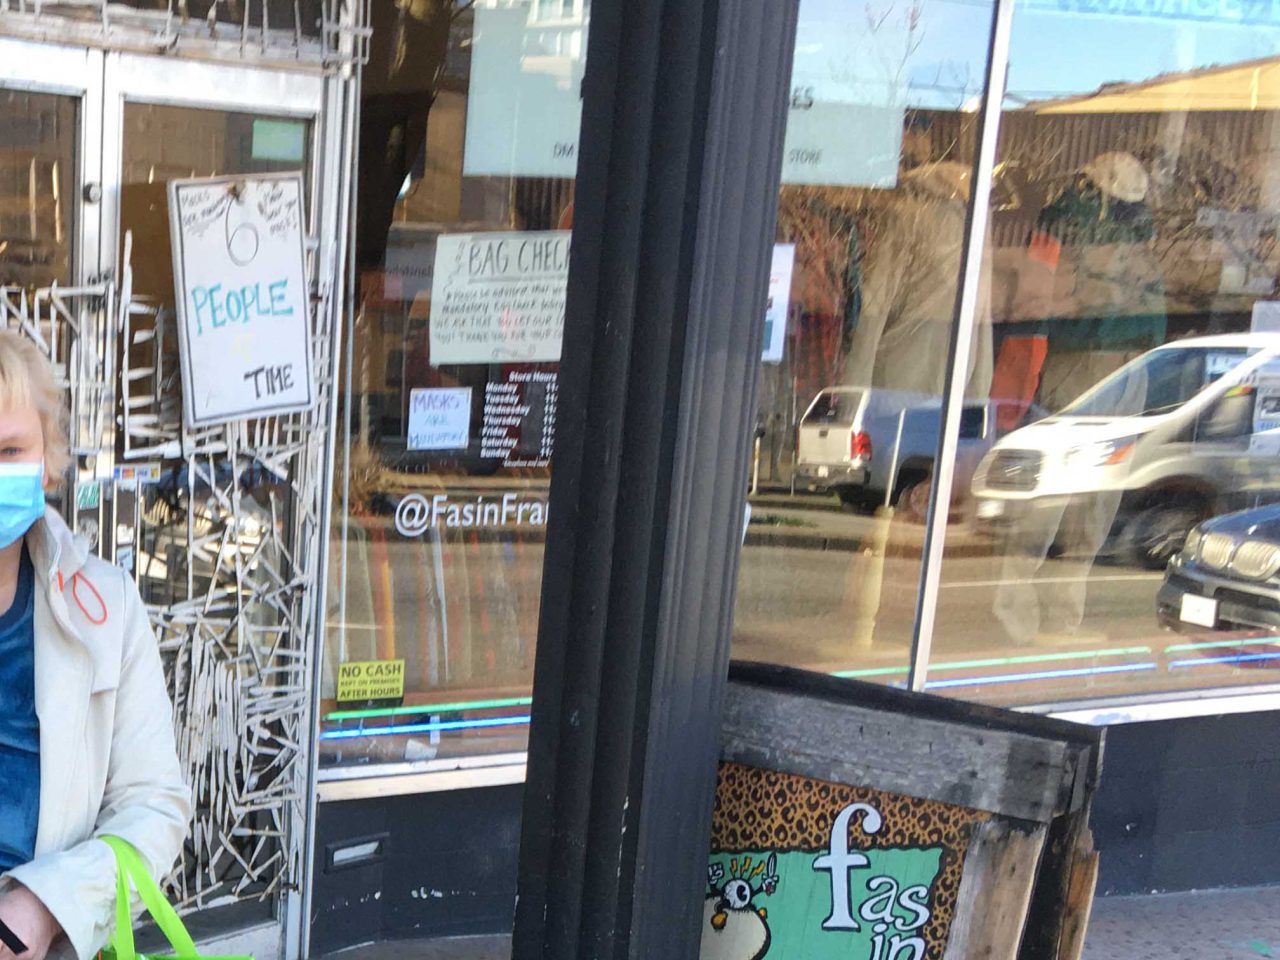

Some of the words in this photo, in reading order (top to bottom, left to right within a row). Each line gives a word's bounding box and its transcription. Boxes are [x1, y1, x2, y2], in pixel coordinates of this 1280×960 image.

[225, 199, 260, 267] 6
[468, 240, 509, 276] BAG
[190, 278, 294, 337] PEOPLE
[485, 382, 518, 394] Monday
[485, 392, 520, 405] Tuesday
[483, 404, 531, 416] Wednesday
[483, 415, 521, 427] Thursday
[482, 426, 508, 438] Friday
[481, 437, 518, 449] Saturday
[480, 447, 512, 459] Sunday
[341, 665, 362, 679] NO
[365, 664, 402, 677] CASH
[340, 688, 368, 698] AFTER
[370, 687, 401, 697] HOURS
